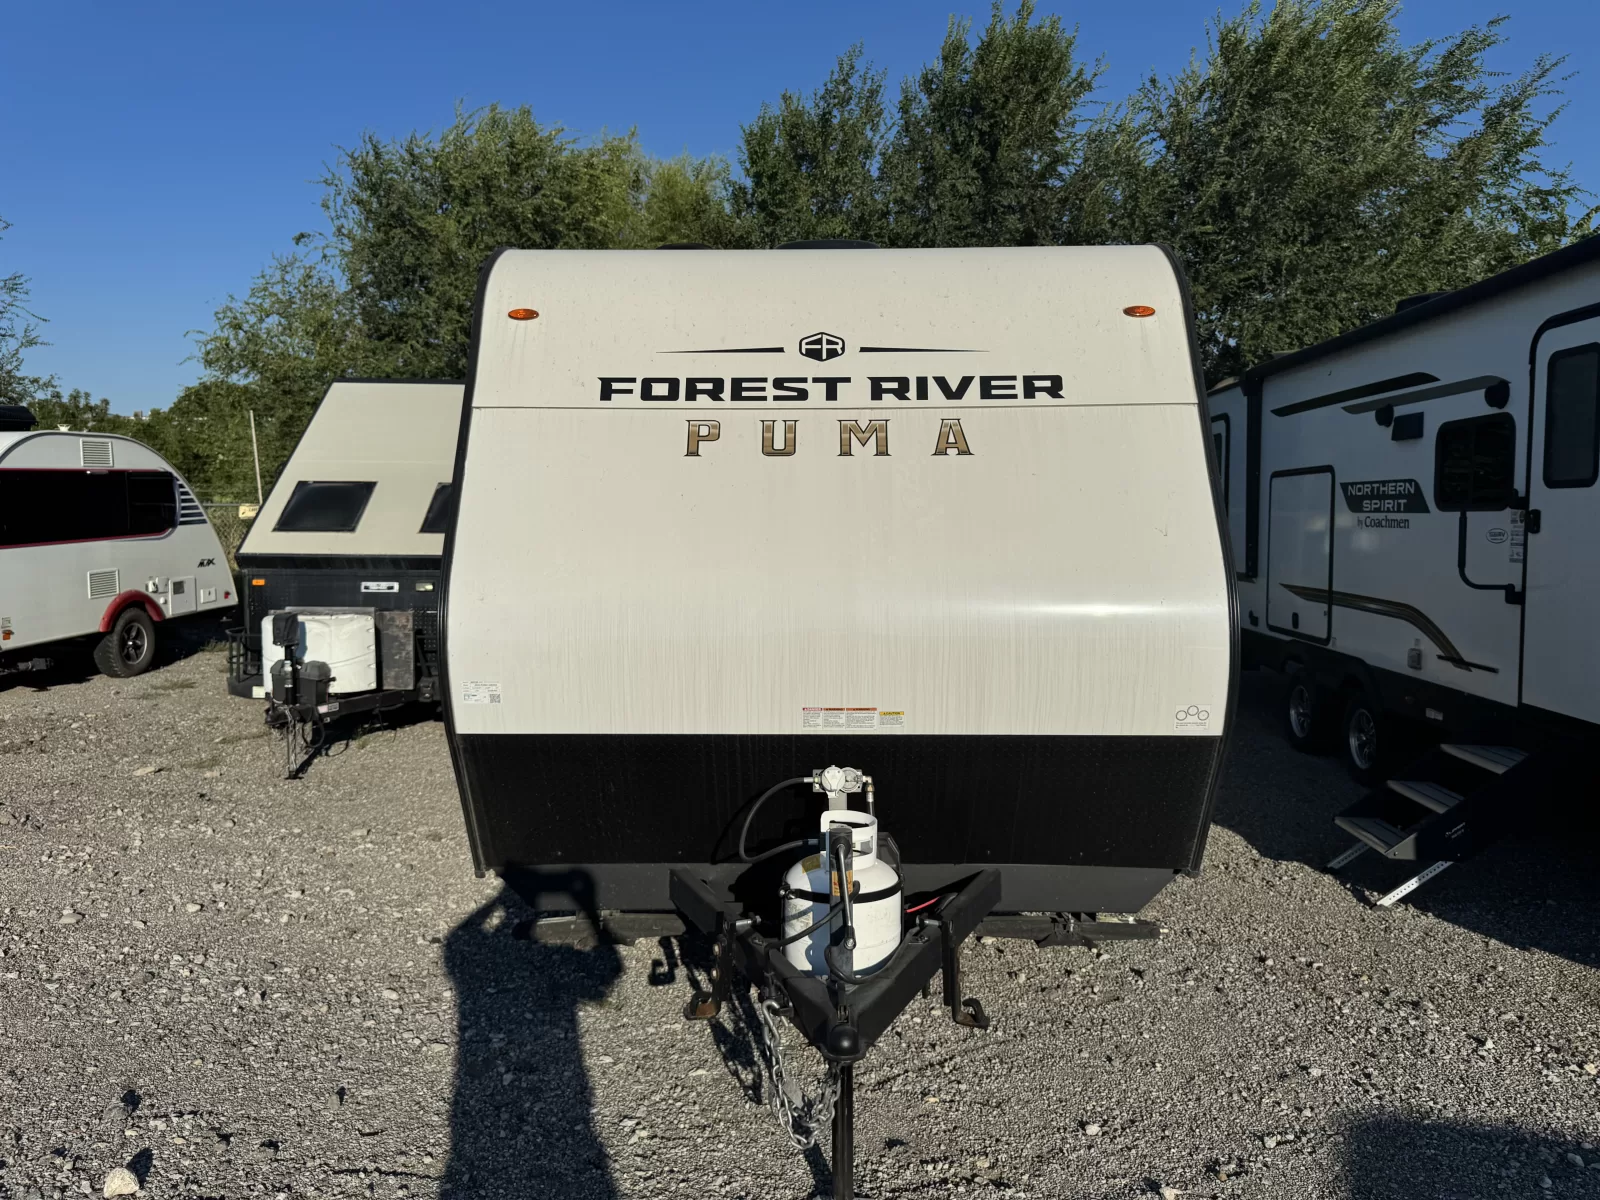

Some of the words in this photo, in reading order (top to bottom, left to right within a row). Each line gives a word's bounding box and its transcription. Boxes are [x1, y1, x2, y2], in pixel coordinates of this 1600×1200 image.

[598, 376, 851, 401] FOREST
[866, 374, 1065, 401] RIVER
[684, 418, 975, 457] PUMA
[1348, 481, 1415, 496] NORTHERN
[1362, 499, 1407, 512] SPIRIT
[1364, 515, 1410, 529] Coachmen
